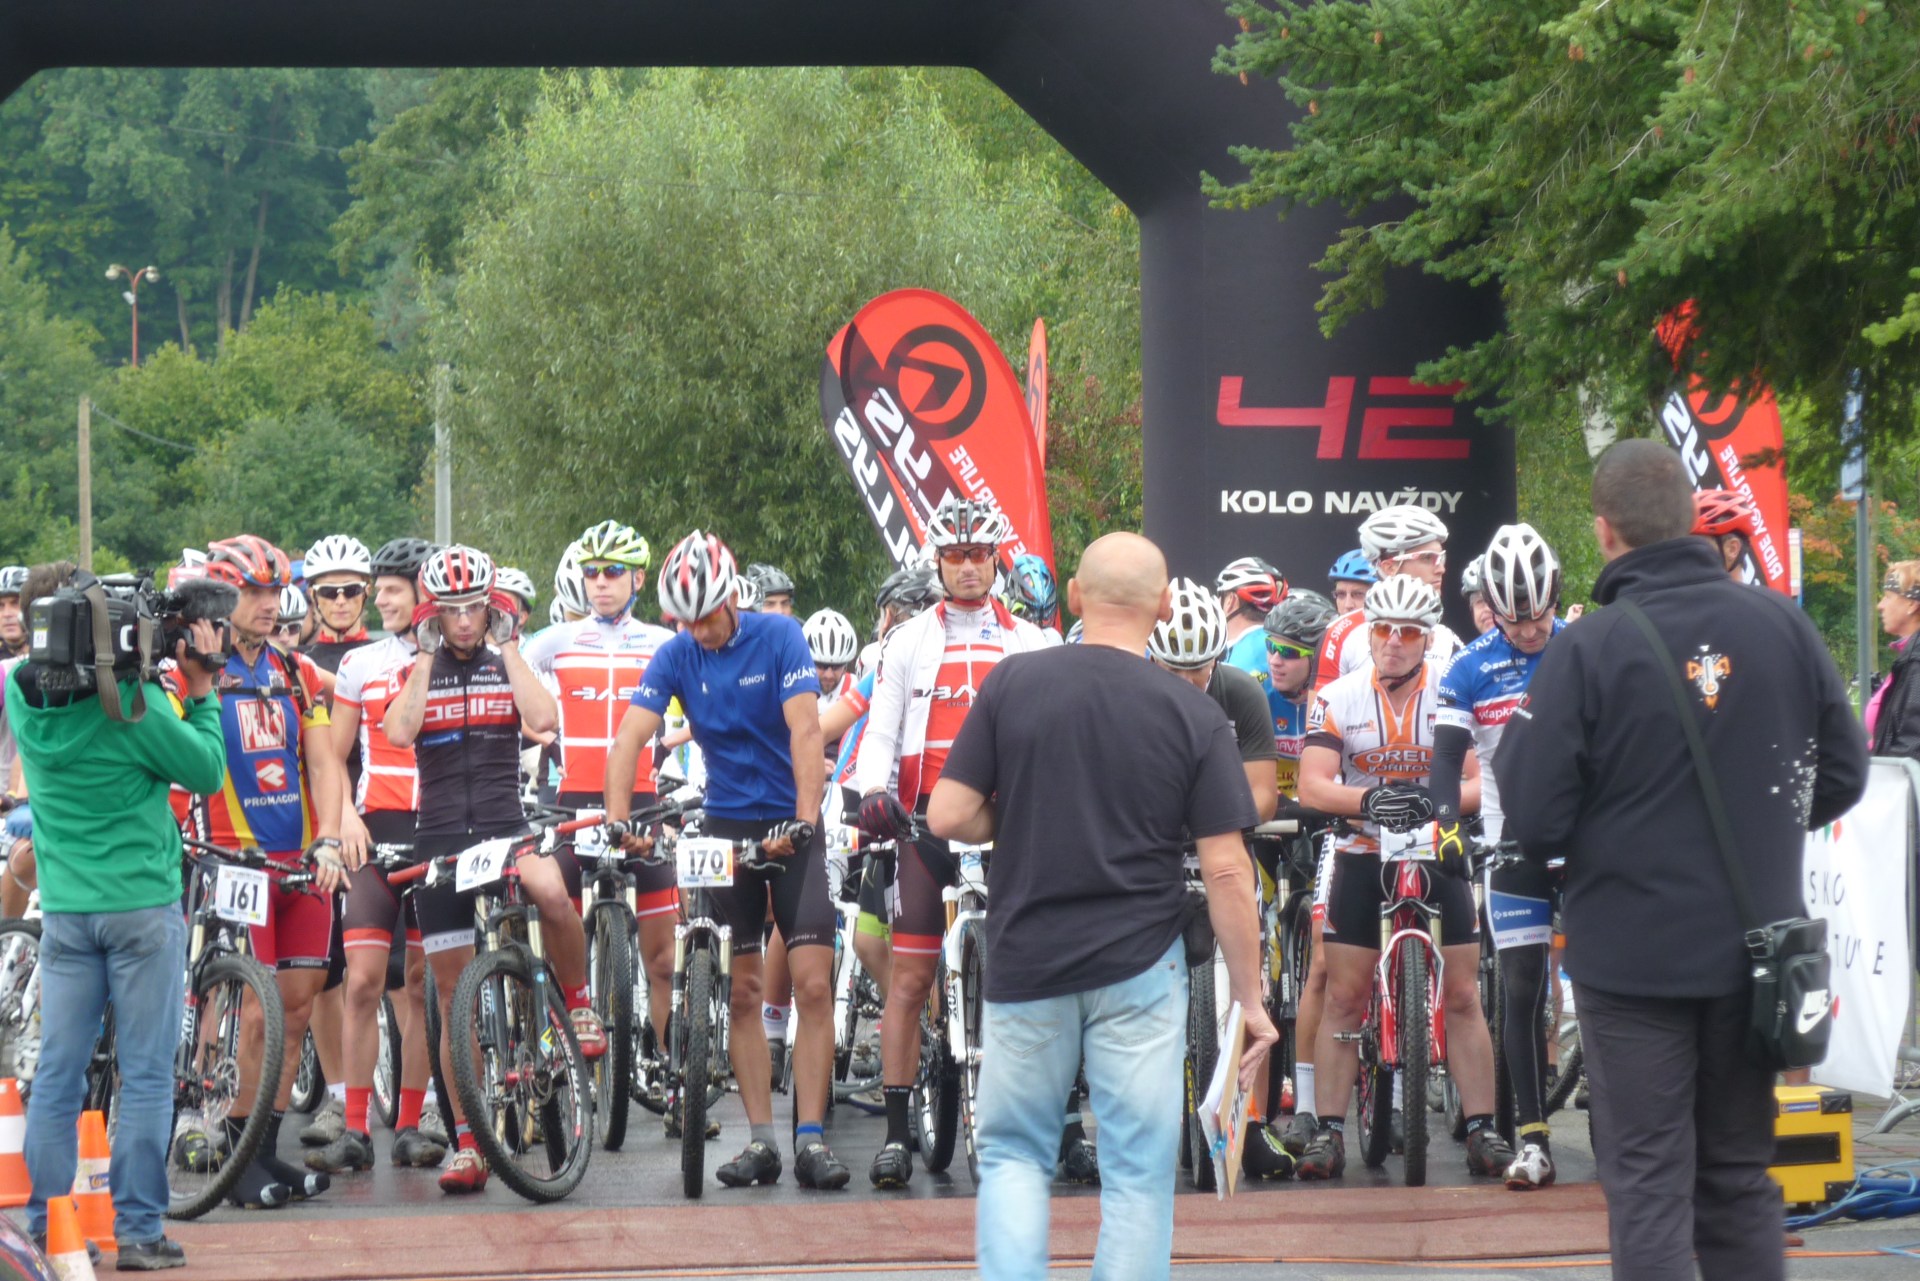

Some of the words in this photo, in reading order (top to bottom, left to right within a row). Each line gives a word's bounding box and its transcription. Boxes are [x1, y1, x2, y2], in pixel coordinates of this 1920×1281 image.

[1221, 490, 1313, 514] KOLO
[1324, 486, 1463, 514] NAVŽDY
[1325, 642, 1338, 660] DT
[1333, 617, 1353, 641] SWISS
[738, 673, 767, 688] TIŠNOV
[1366, 750, 1431, 764] OREL
[244, 793, 300, 808] PROMACOM
[469, 852, 492, 875] 46
[688, 850, 724, 875] 170
[229, 880, 259, 912] 161
[1502, 908, 1532, 918] some
